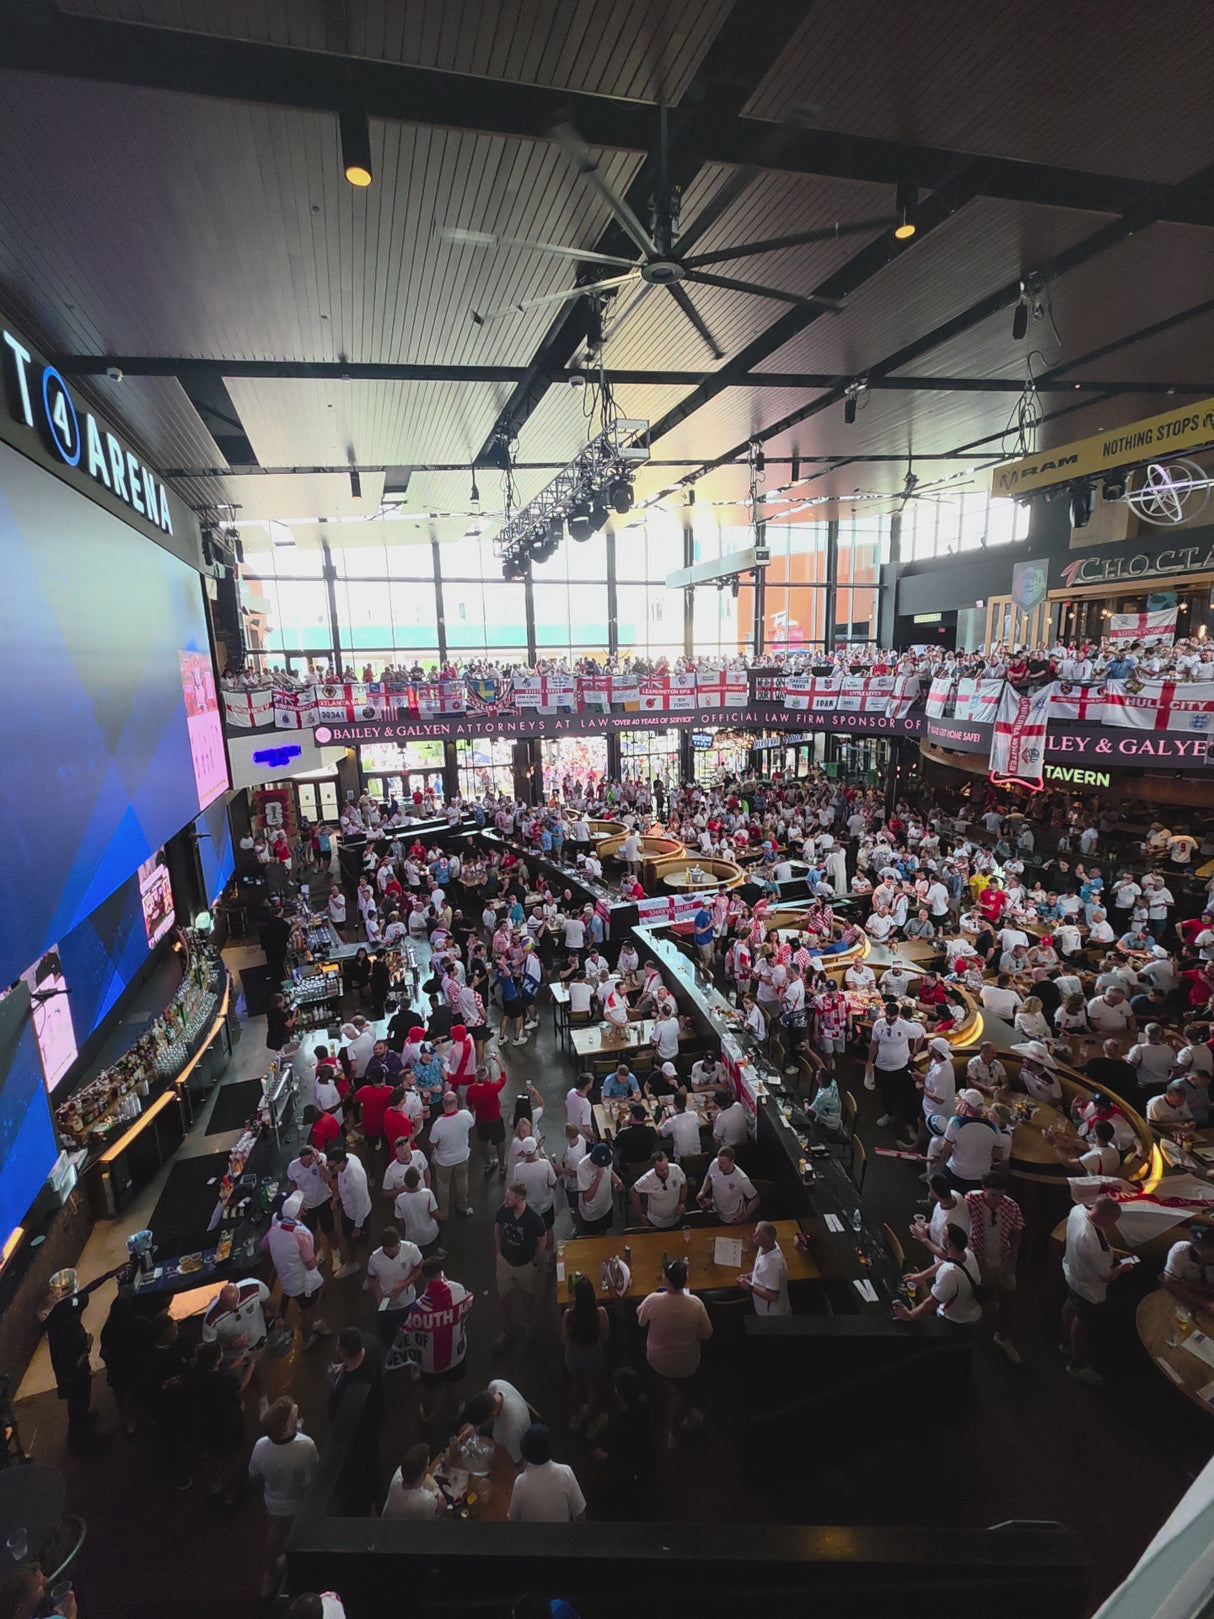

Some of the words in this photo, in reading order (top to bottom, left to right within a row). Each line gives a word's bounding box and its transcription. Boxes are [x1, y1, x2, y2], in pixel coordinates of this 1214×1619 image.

[3, 330, 33, 428] T
[53, 390, 72, 448] 4
[87, 412, 174, 536] ARENA
[1102, 429, 1153, 458] NOTHING
[1156, 414, 1199, 442] STOPS
[1020, 454, 1079, 479] RAM
[1125, 696, 1164, 709] HULL
[1169, 700, 1207, 711] CITY
[333, 726, 381, 740] BAILEY
[384, 726, 394, 737] &
[396, 724, 450, 737] GALYEN
[456, 720, 545, 734] ATTORNEYS
[555, 719, 571, 730] AT
[581, 718, 609, 728] LAW
[631, 718, 640, 726] 40
[640, 717, 659, 725] YEARS
[660, 716, 669, 724] OF
[701, 712, 759, 723] OFFICIAL
[765, 712, 789, 722] LAW
[796, 713, 825, 725] FIRM
[832, 715, 895, 729] SPONSOR
[904, 719, 922, 730] OF
[1046, 734, 1092, 753] LEY
[1095, 737, 1113, 754] &
[1118, 739, 1208, 757] GALYE
[1044, 764, 1111, 788] TAVERN
